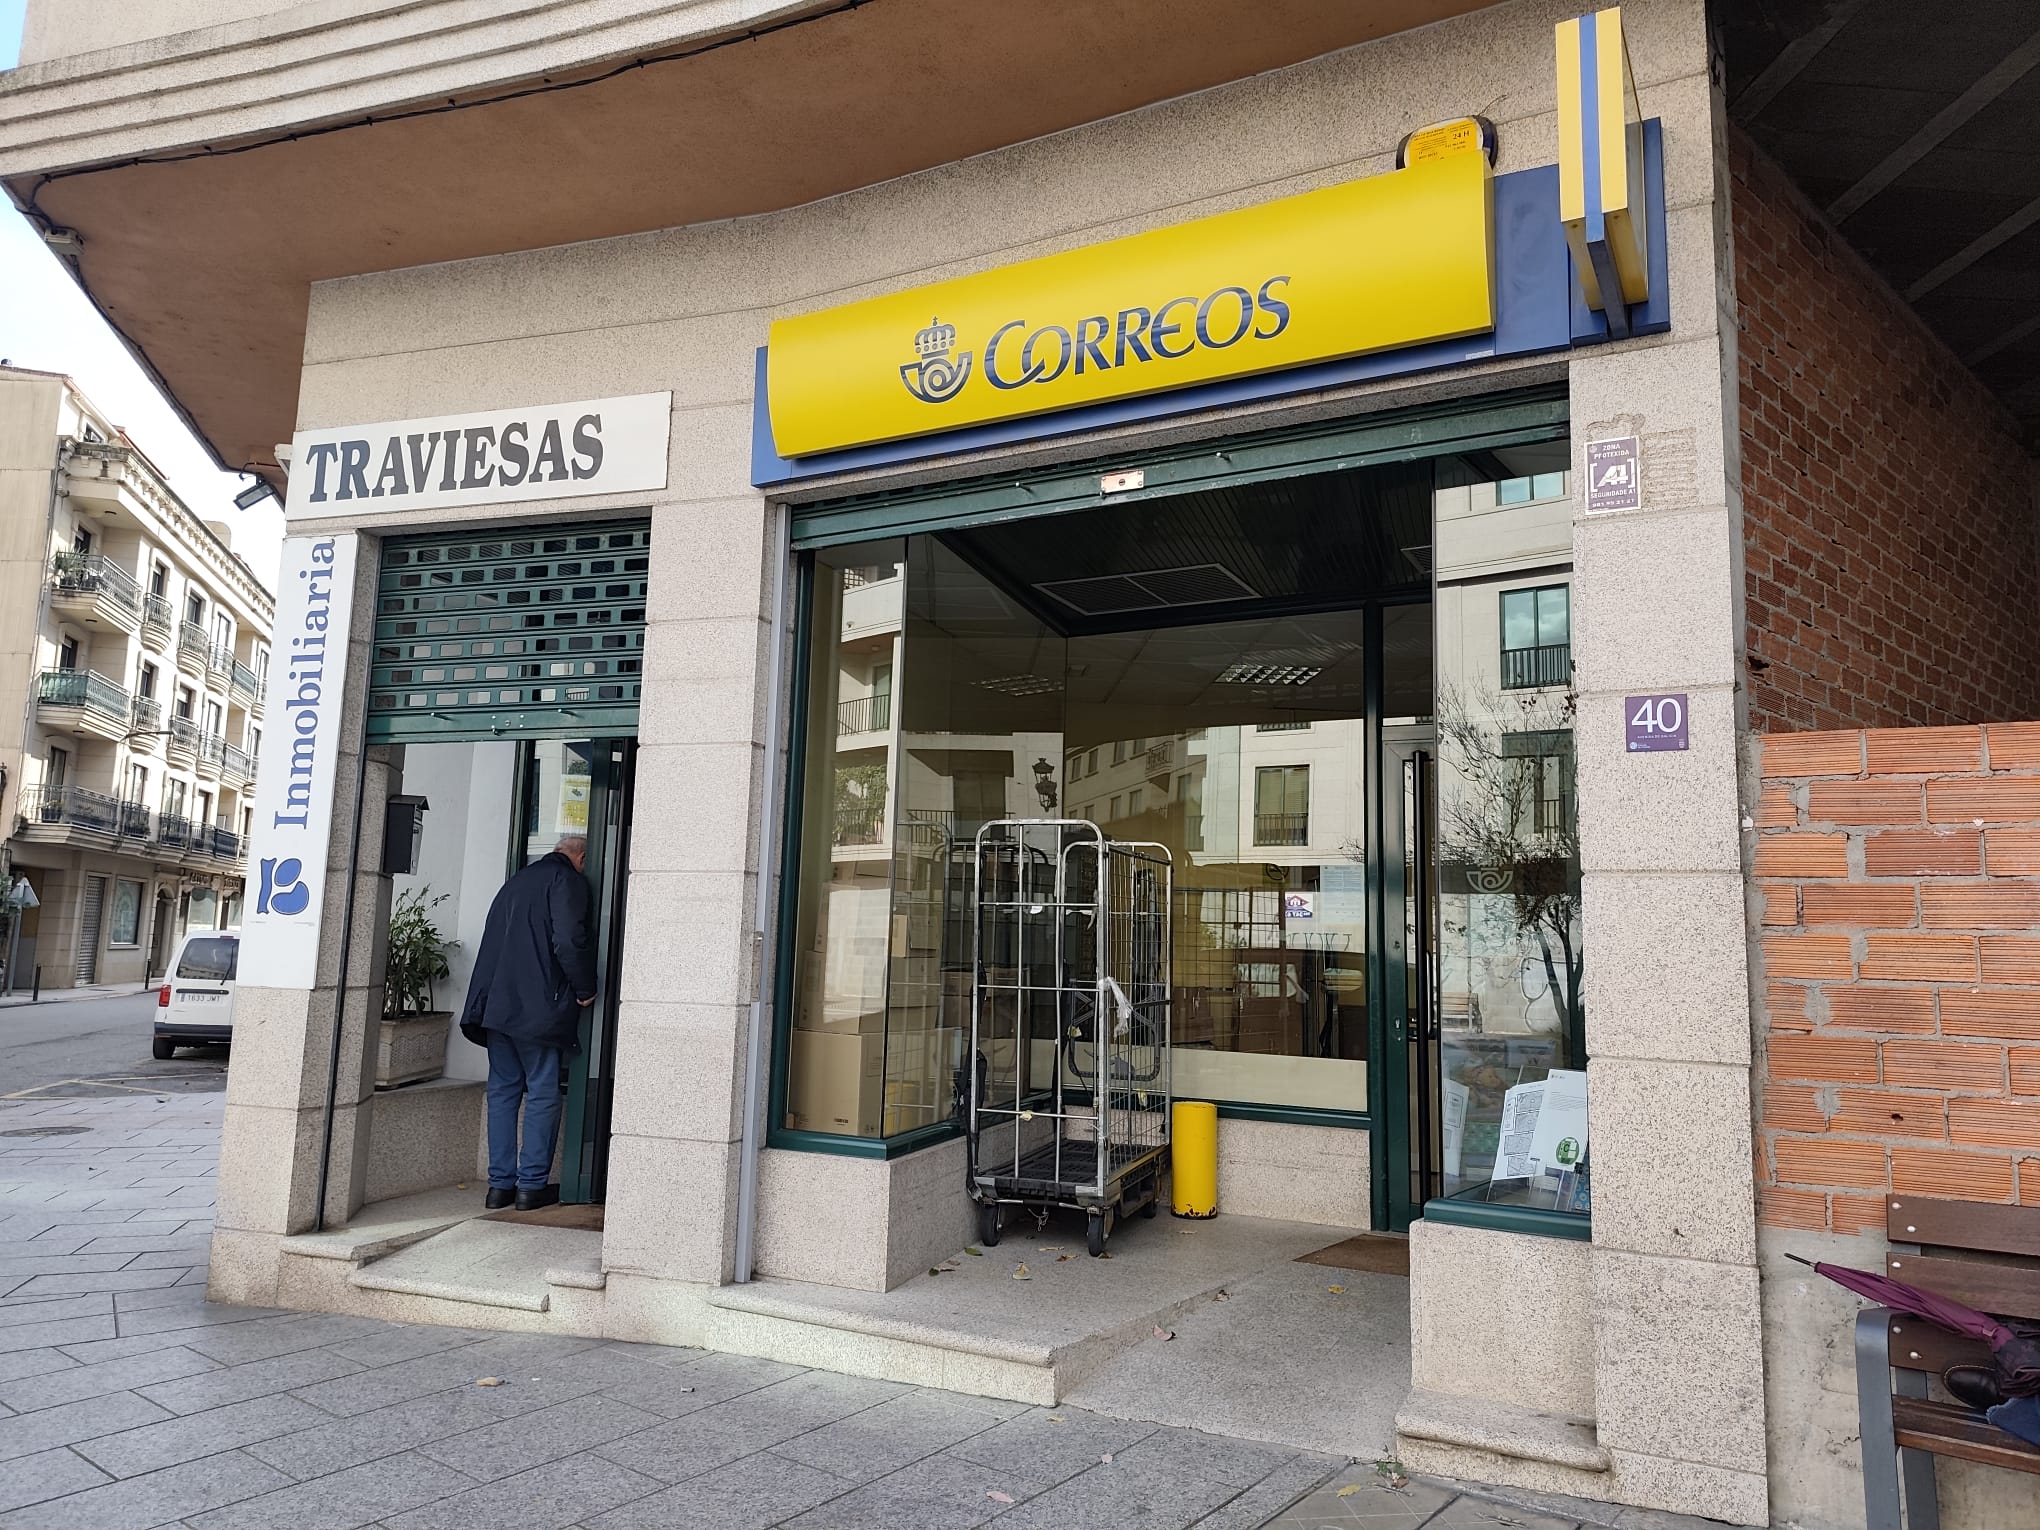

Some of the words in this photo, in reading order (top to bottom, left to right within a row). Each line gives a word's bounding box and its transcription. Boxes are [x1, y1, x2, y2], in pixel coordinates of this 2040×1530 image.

[1453, 132, 1462, 140] 24
[984, 275, 1291, 390] CORREOS
[306, 413, 604, 503] TRAVIESAS
[1594, 449, 1630, 460] PROTEXIDA
[1602, 443, 1621, 451] ZONA
[1590, 489, 1627, 499] SEGURIDADE
[273, 538, 336, 830] Inmobiliaria
[1631, 698, 1682, 733] 40
